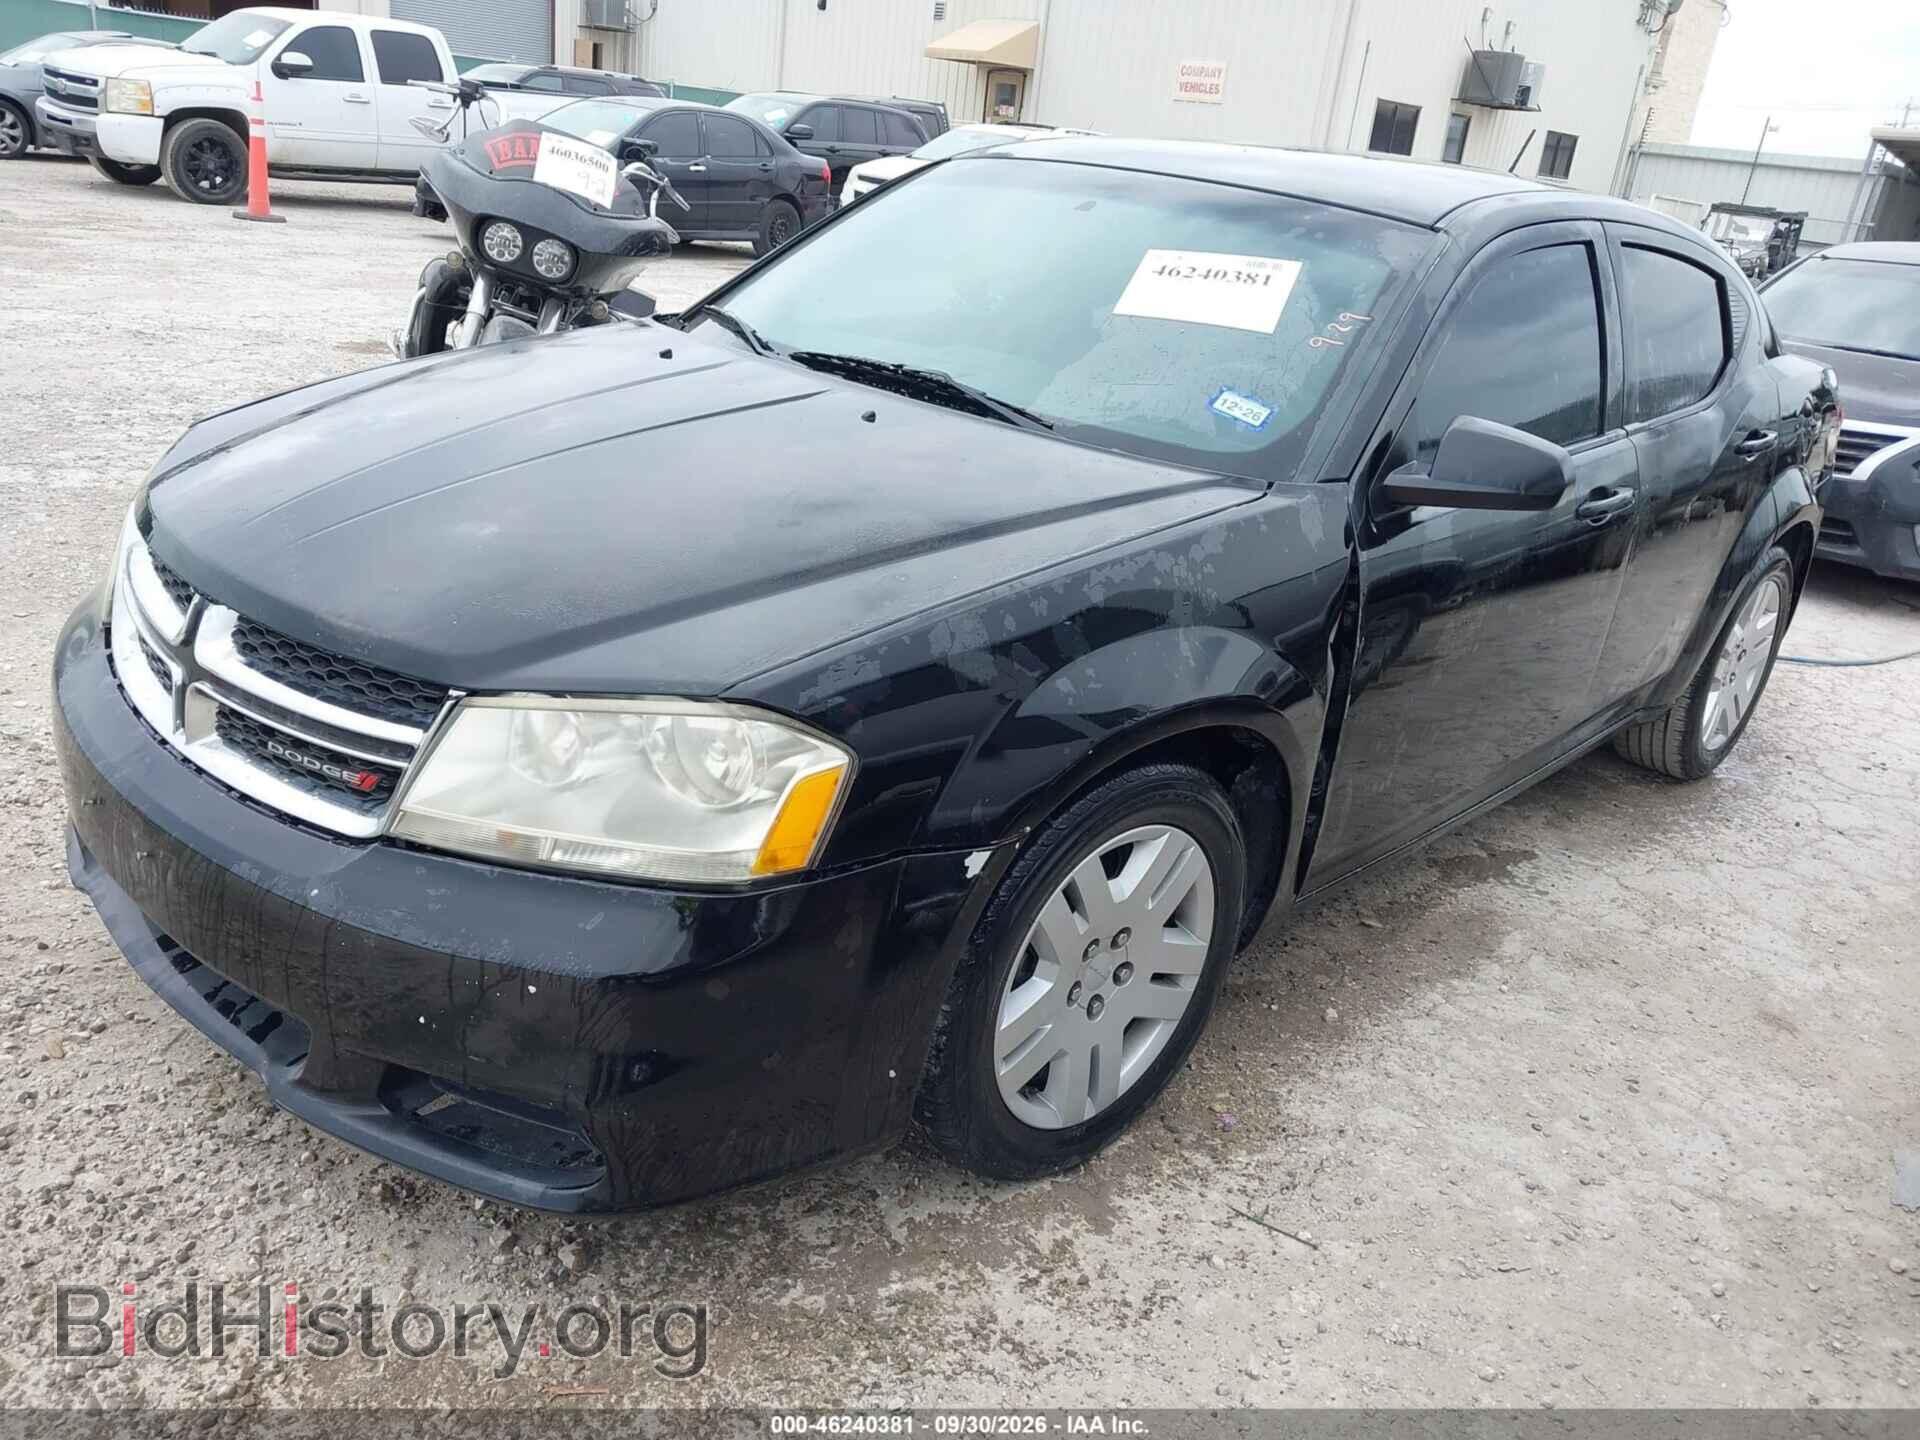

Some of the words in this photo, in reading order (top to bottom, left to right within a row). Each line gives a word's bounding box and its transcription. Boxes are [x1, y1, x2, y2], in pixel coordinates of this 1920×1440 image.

[1180, 65, 1223, 80] COMPANY
[1179, 81, 1220, 95] VEHICLES
[549, 146, 609, 173] 46036500
[1151, 264, 1272, 286] 46240381
[267, 741, 361, 785] DODGE
